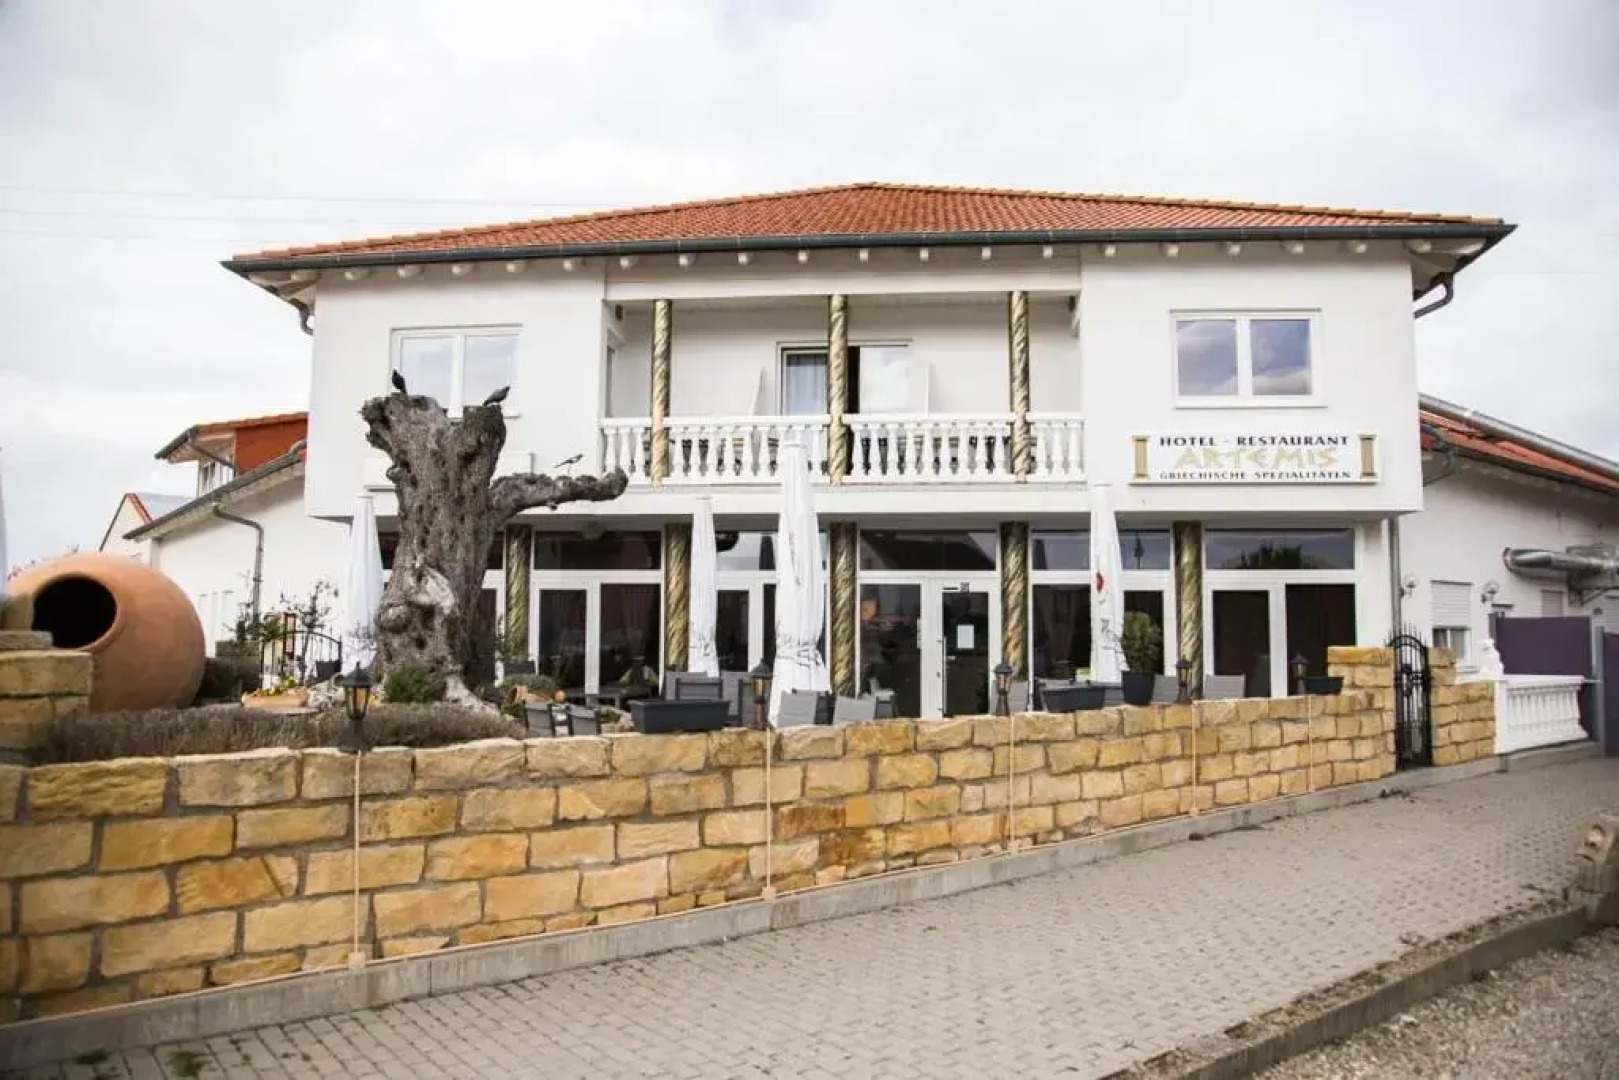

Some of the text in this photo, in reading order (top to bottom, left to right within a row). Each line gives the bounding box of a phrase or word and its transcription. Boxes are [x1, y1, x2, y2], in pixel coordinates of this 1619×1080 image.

[1160, 436, 1214, 447] HOTEL
[1237, 435, 1348, 447] RESTAURANT
[1173, 447, 1338, 469] ARTEMIS
[1160, 470, 1246, 480] GRIECHISCHE
